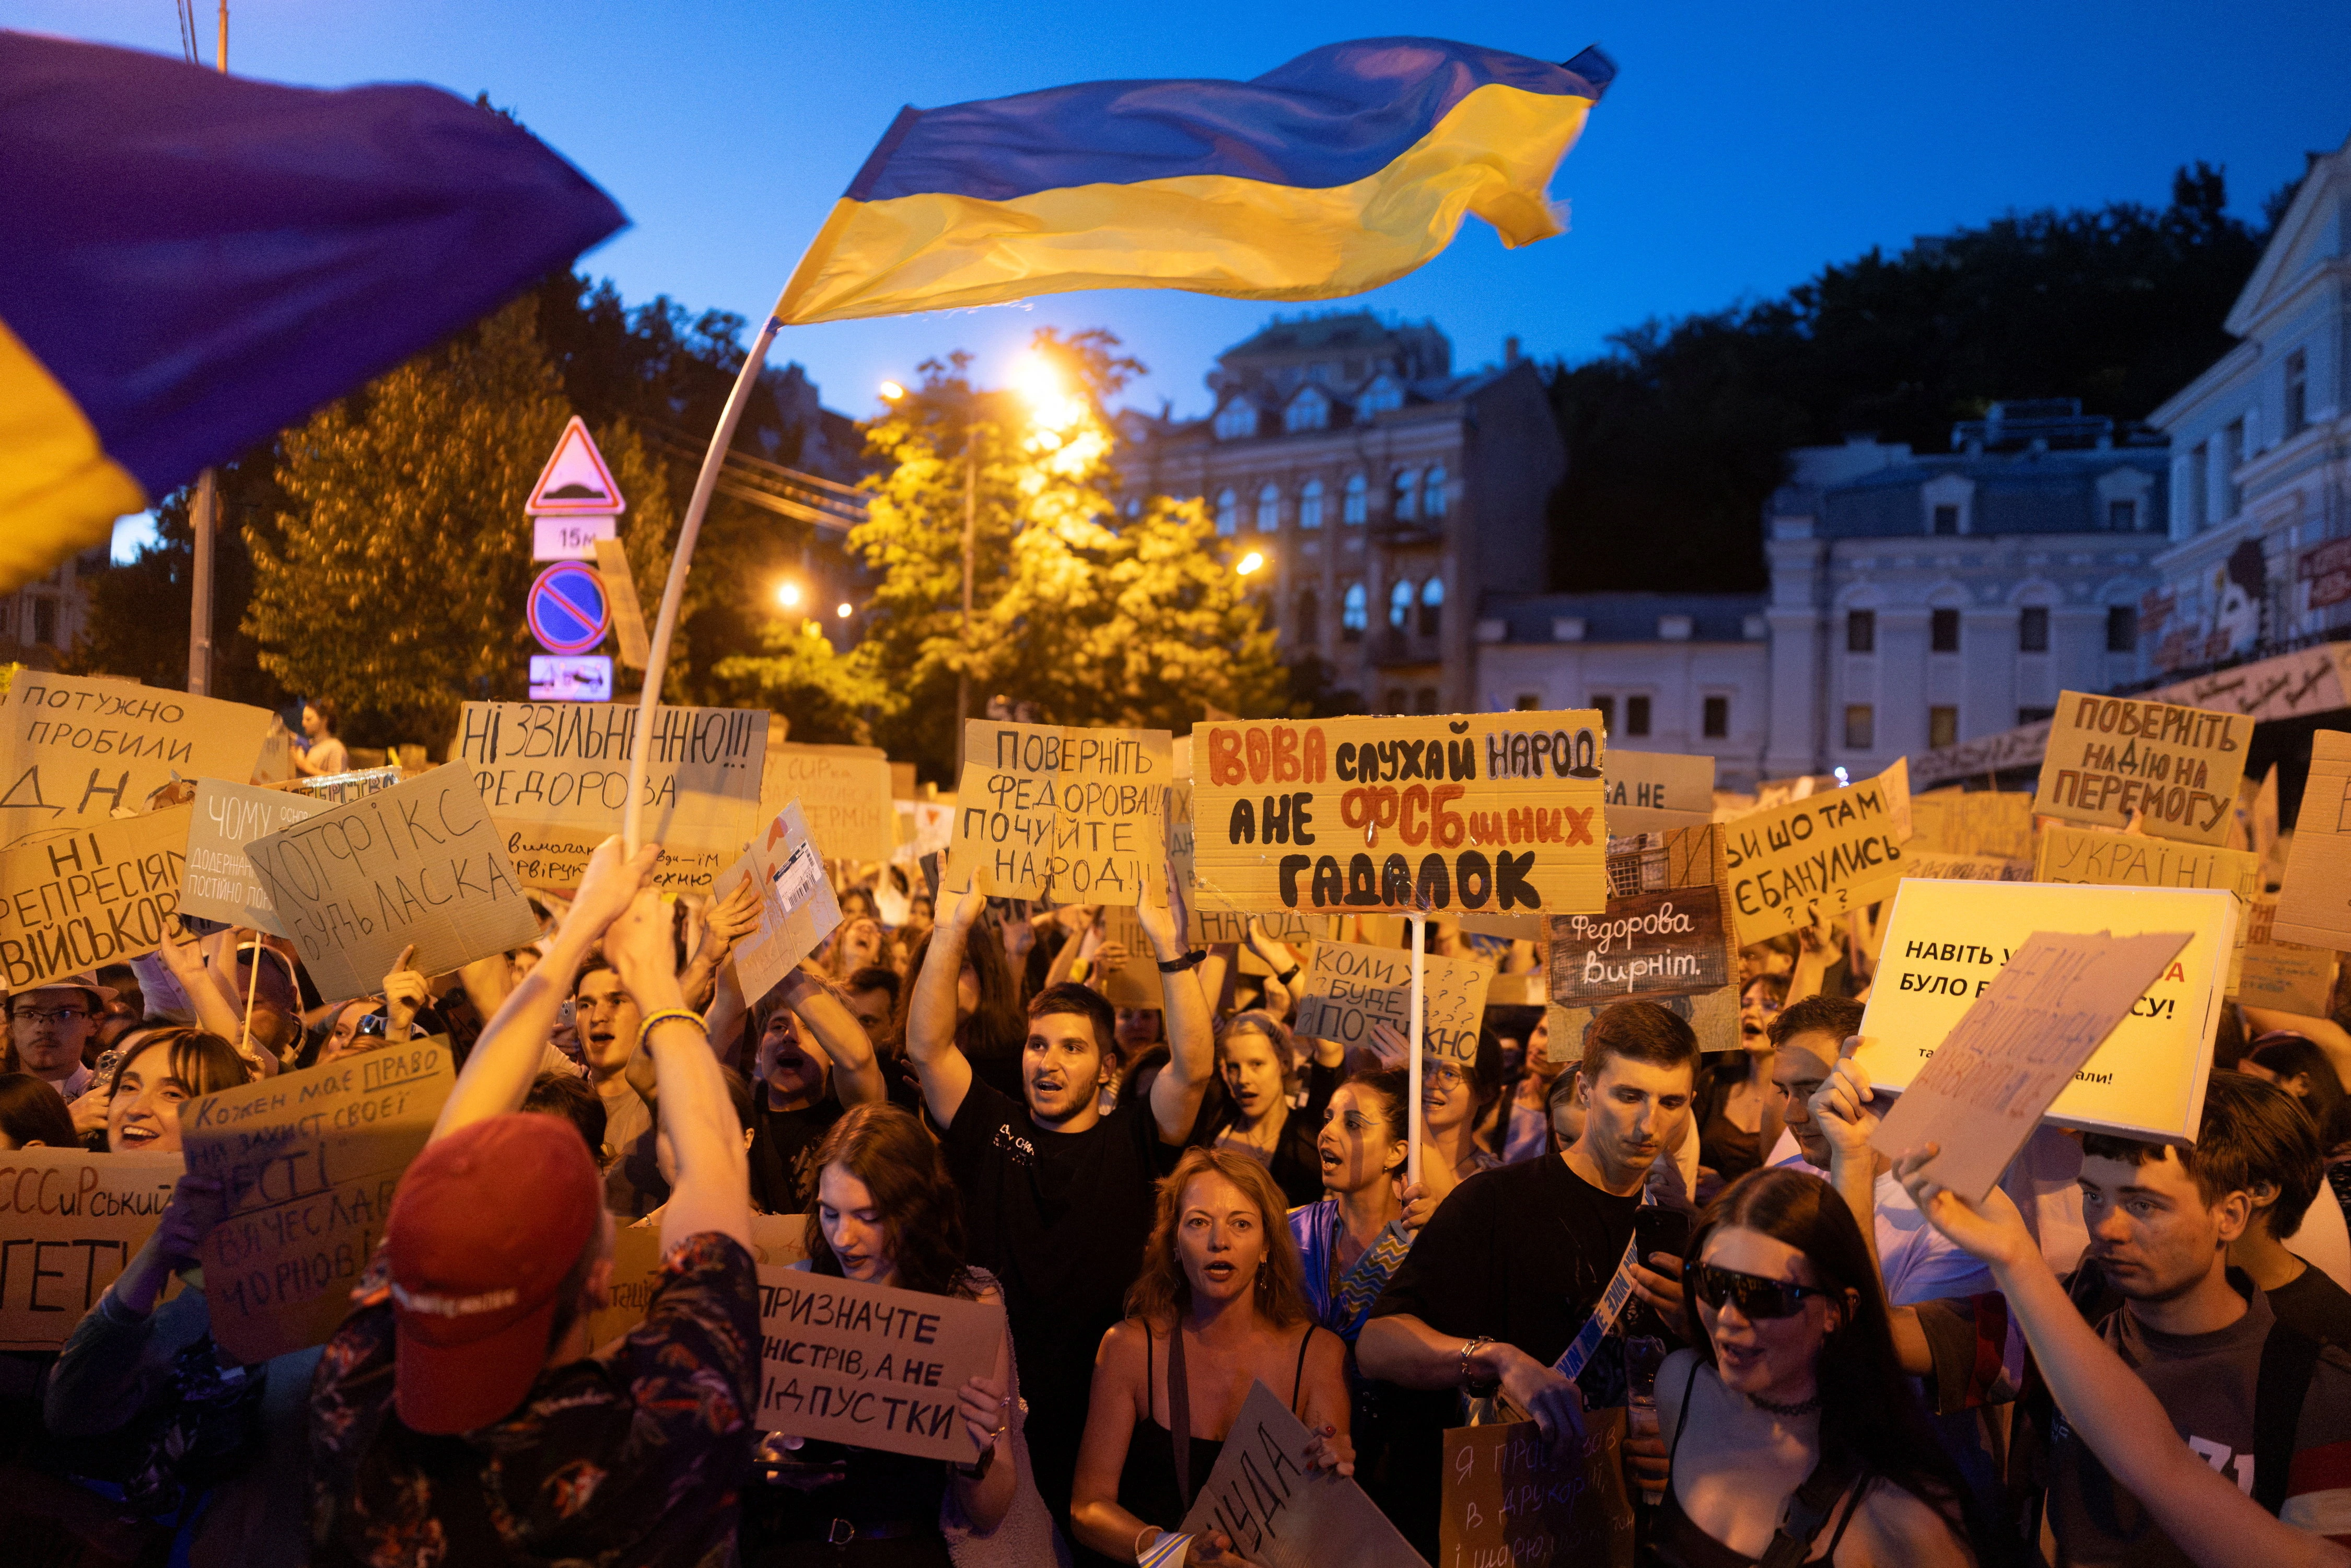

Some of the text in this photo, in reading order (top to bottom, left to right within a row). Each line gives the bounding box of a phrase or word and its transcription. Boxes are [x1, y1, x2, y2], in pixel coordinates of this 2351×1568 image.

[23, 686, 184, 723] ПОТУЖНО
[2075, 698, 2238, 751] ПОВЕРНІТЬ
[27, 722, 192, 763] ПРОБИЛИ
[462, 705, 502, 764] НІ
[997, 730, 1152, 775] ПОВЕРНІТЬ
[1208, 720, 1603, 786] ВОВА СЛУХАЙ НАРОД
[2081, 737, 2171, 781] НАДІЮ
[2175, 757, 2208, 788] НА
[281, 773, 395, 804] ТЕРСТВО
[987, 774, 1168, 817] ФЕДОРОВА!!!
[1637, 782, 1665, 809] НЕ
[2053, 770, 2231, 832] ПЕРЕМОГУ
[210, 795, 312, 841] ЧОМУ ОСНОВ
[964, 807, 1136, 852] ПОЧУЙТЕ
[1768, 814, 1813, 852] ШО
[1819, 791, 1881, 828] ТАМ
[47, 833, 103, 877] НІ
[251, 789, 481, 909] ХОТФІКС
[2058, 836, 2215, 889] УКРАЇНІ
[188, 875, 241, 903] ПОСТІЙНО
[1279, 850, 1542, 910] ГАДАЛОК
[1735, 836, 1901, 915] ЄБАНУЛИСЬ
[294, 852, 517, 960] БУДЬ ЛАСКА
[1572, 902, 1695, 954] Федорова
[0, 889, 186, 986] ВІЙСЬКОВ
[1905, 940, 1994, 965] НАВІТЬ
[1314, 947, 1393, 983] КОЛИ
[1330, 979, 1404, 1015] БУДЕ
[1900, 973, 1968, 997] БУЛО
[2130, 996, 2175, 1020] СУ!
[363, 1049, 439, 1090] ПРАВО
[2074, 1071, 2113, 1085] али!
[222, 1232, 371, 1316] ЧОРНОВІ
[1604, 1271, 1630, 1316] NIKE
[758, 1285, 940, 1345] ПРИЗНАЧТЕ
[761, 1336, 944, 1387] НІСТРІВ, А НЕ
[764, 1377, 956, 1441] ІДПУСТКИ
